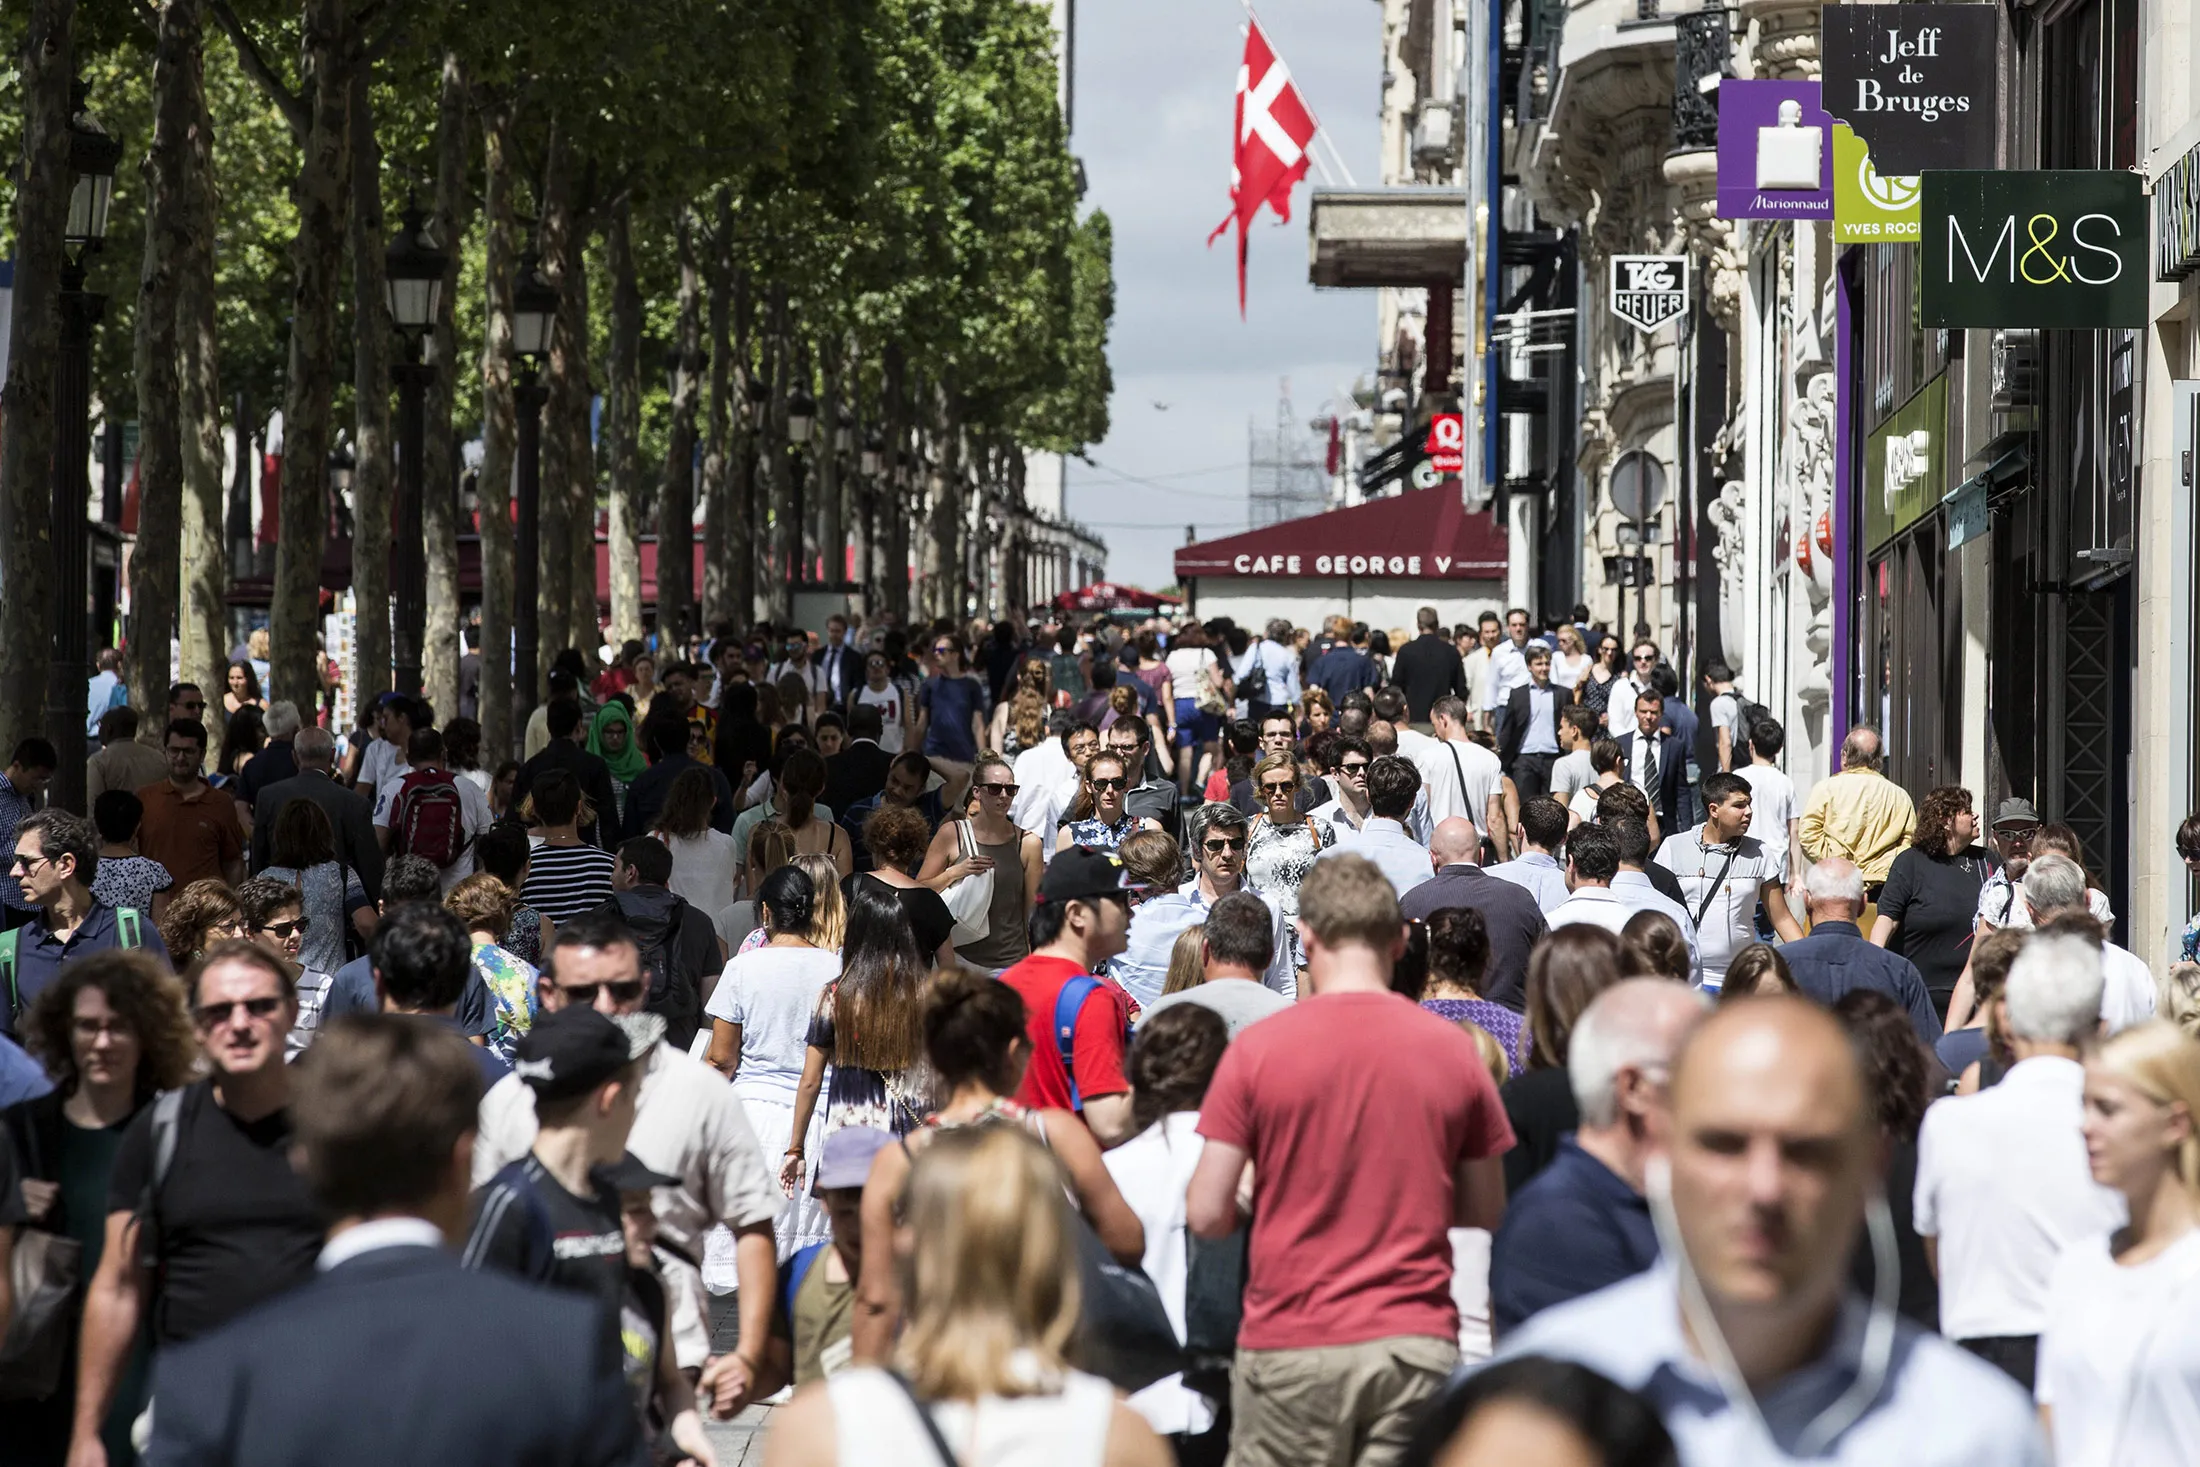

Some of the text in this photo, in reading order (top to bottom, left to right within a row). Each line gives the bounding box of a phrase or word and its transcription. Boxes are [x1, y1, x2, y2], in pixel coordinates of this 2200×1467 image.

[1880, 27, 1942, 64] Jeff
[1898, 64, 1924, 84] de
[1853, 78, 1970, 122] Bruges
[1748, 194, 1829, 212] Marionnaud
[1843, 222, 1881, 236] YVES
[1948, 213, 2122, 285] M&S
[1624, 262, 1676, 290] TAG
[1618, 294, 1681, 325] HEUER
[1435, 418, 1463, 450] Q
[1234, 554, 1452, 574] CAFE GEORGE V
